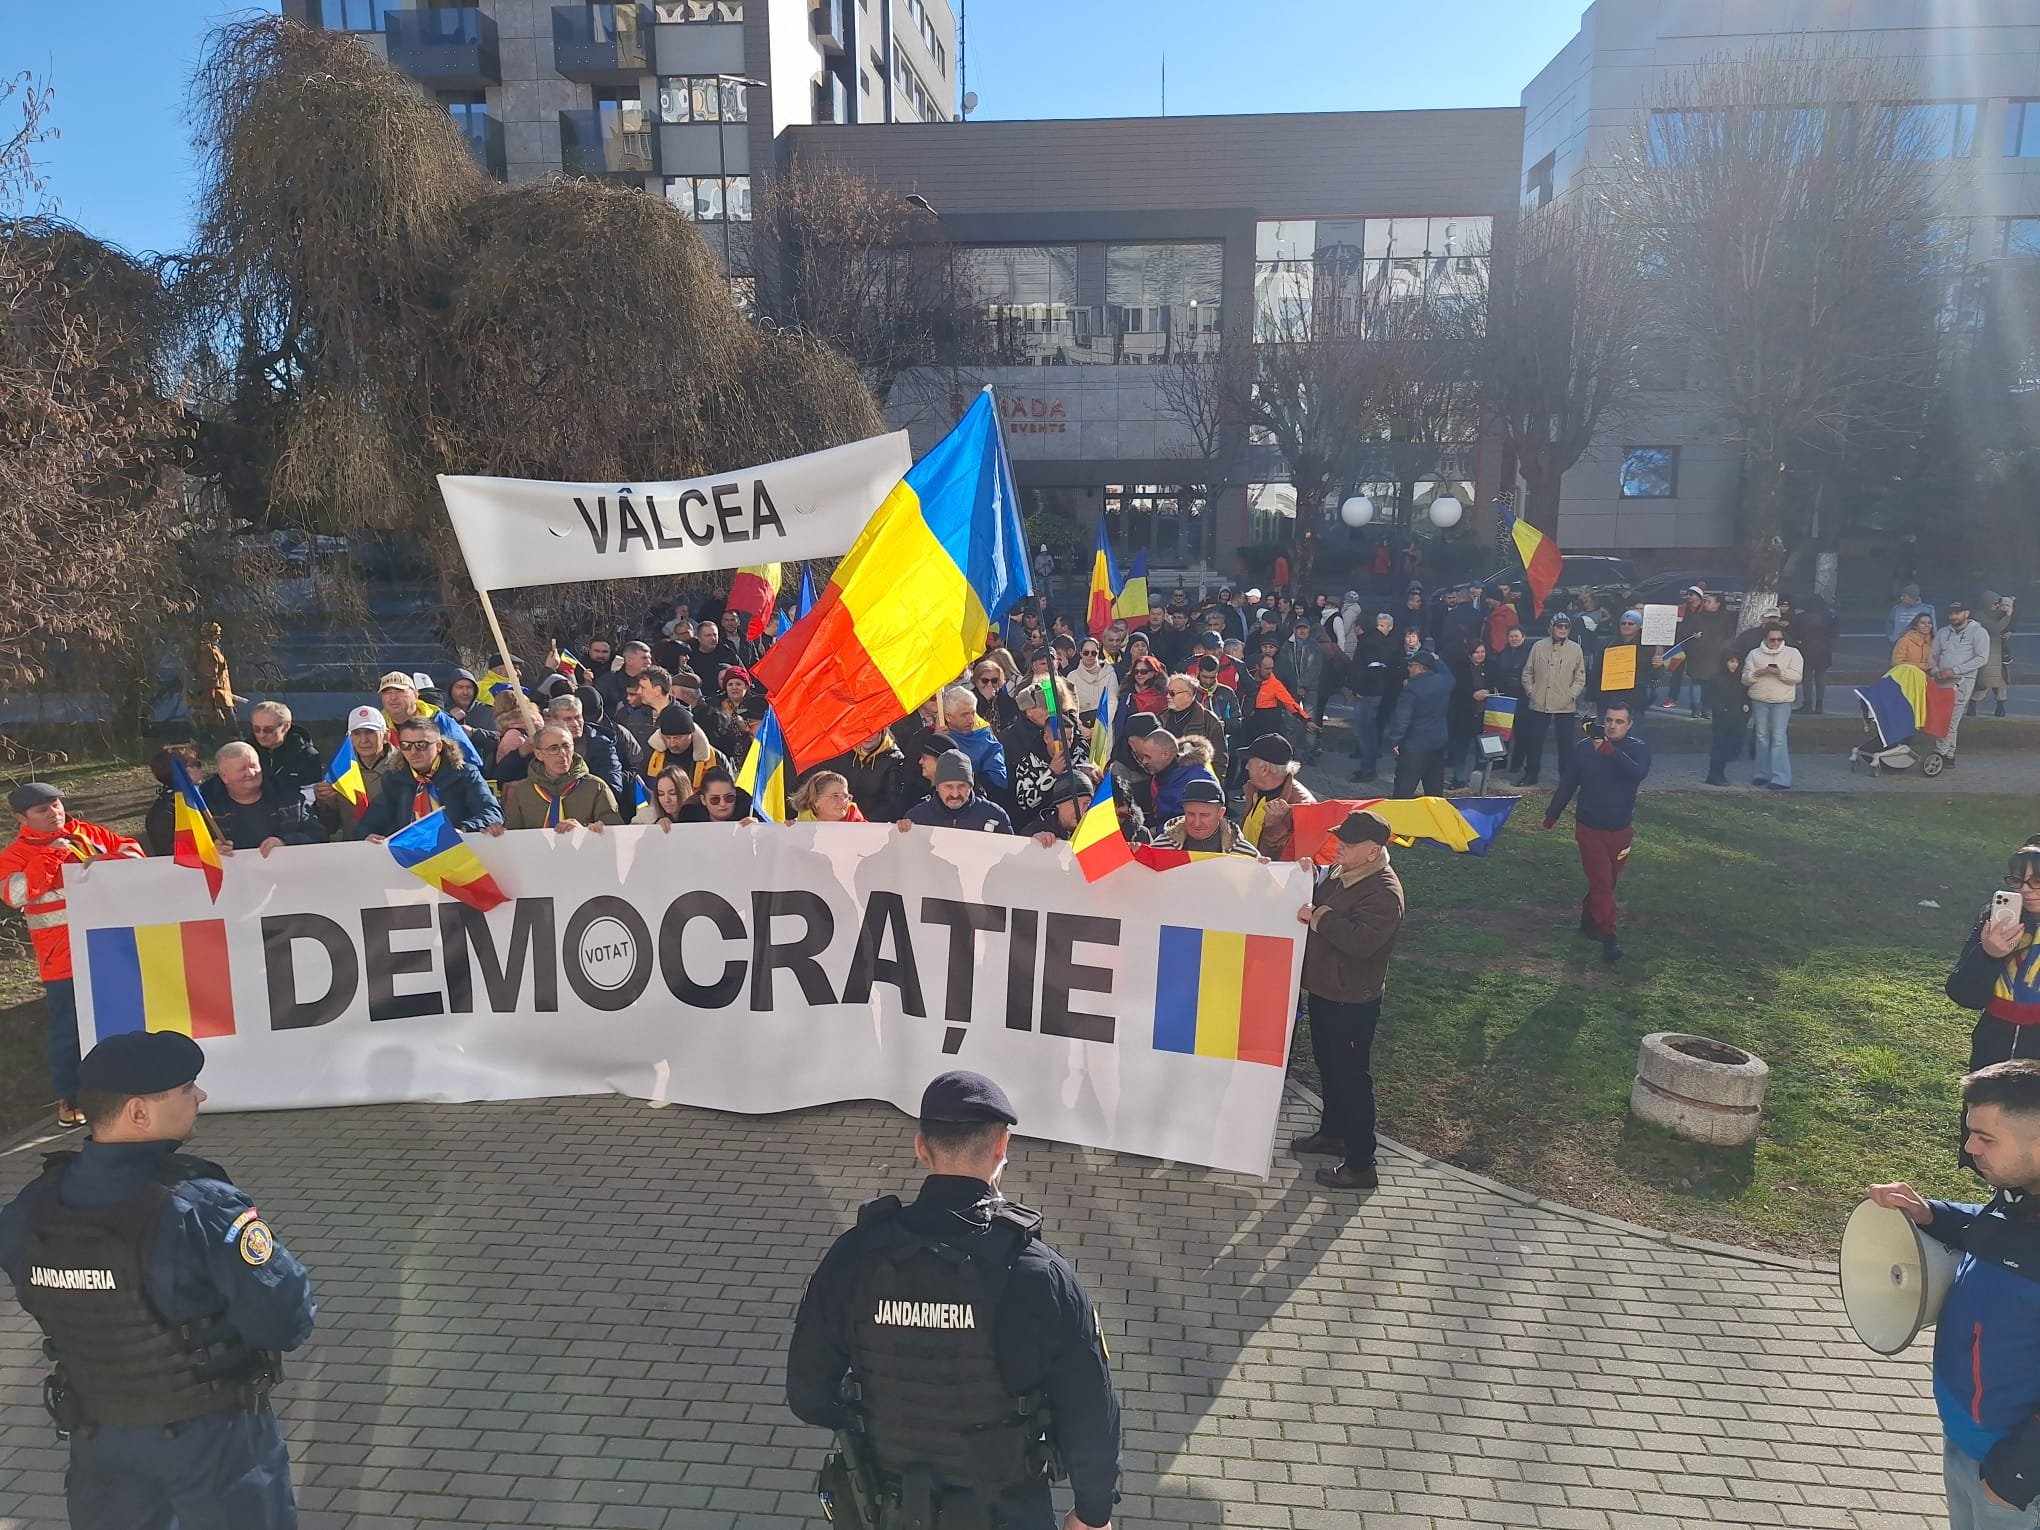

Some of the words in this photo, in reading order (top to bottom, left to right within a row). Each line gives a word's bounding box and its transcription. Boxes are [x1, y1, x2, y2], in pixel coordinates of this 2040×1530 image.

[1010, 422, 1066, 433] EVENTS
[573, 479, 786, 554] VÂLCEA
[585, 941, 628, 964] VOTAT
[260, 890, 1121, 1054] DEMOCRAȚIE
[30, 1266, 116, 1290] JANDARMERIA
[874, 1299, 975, 1329] JANDARMERIA
